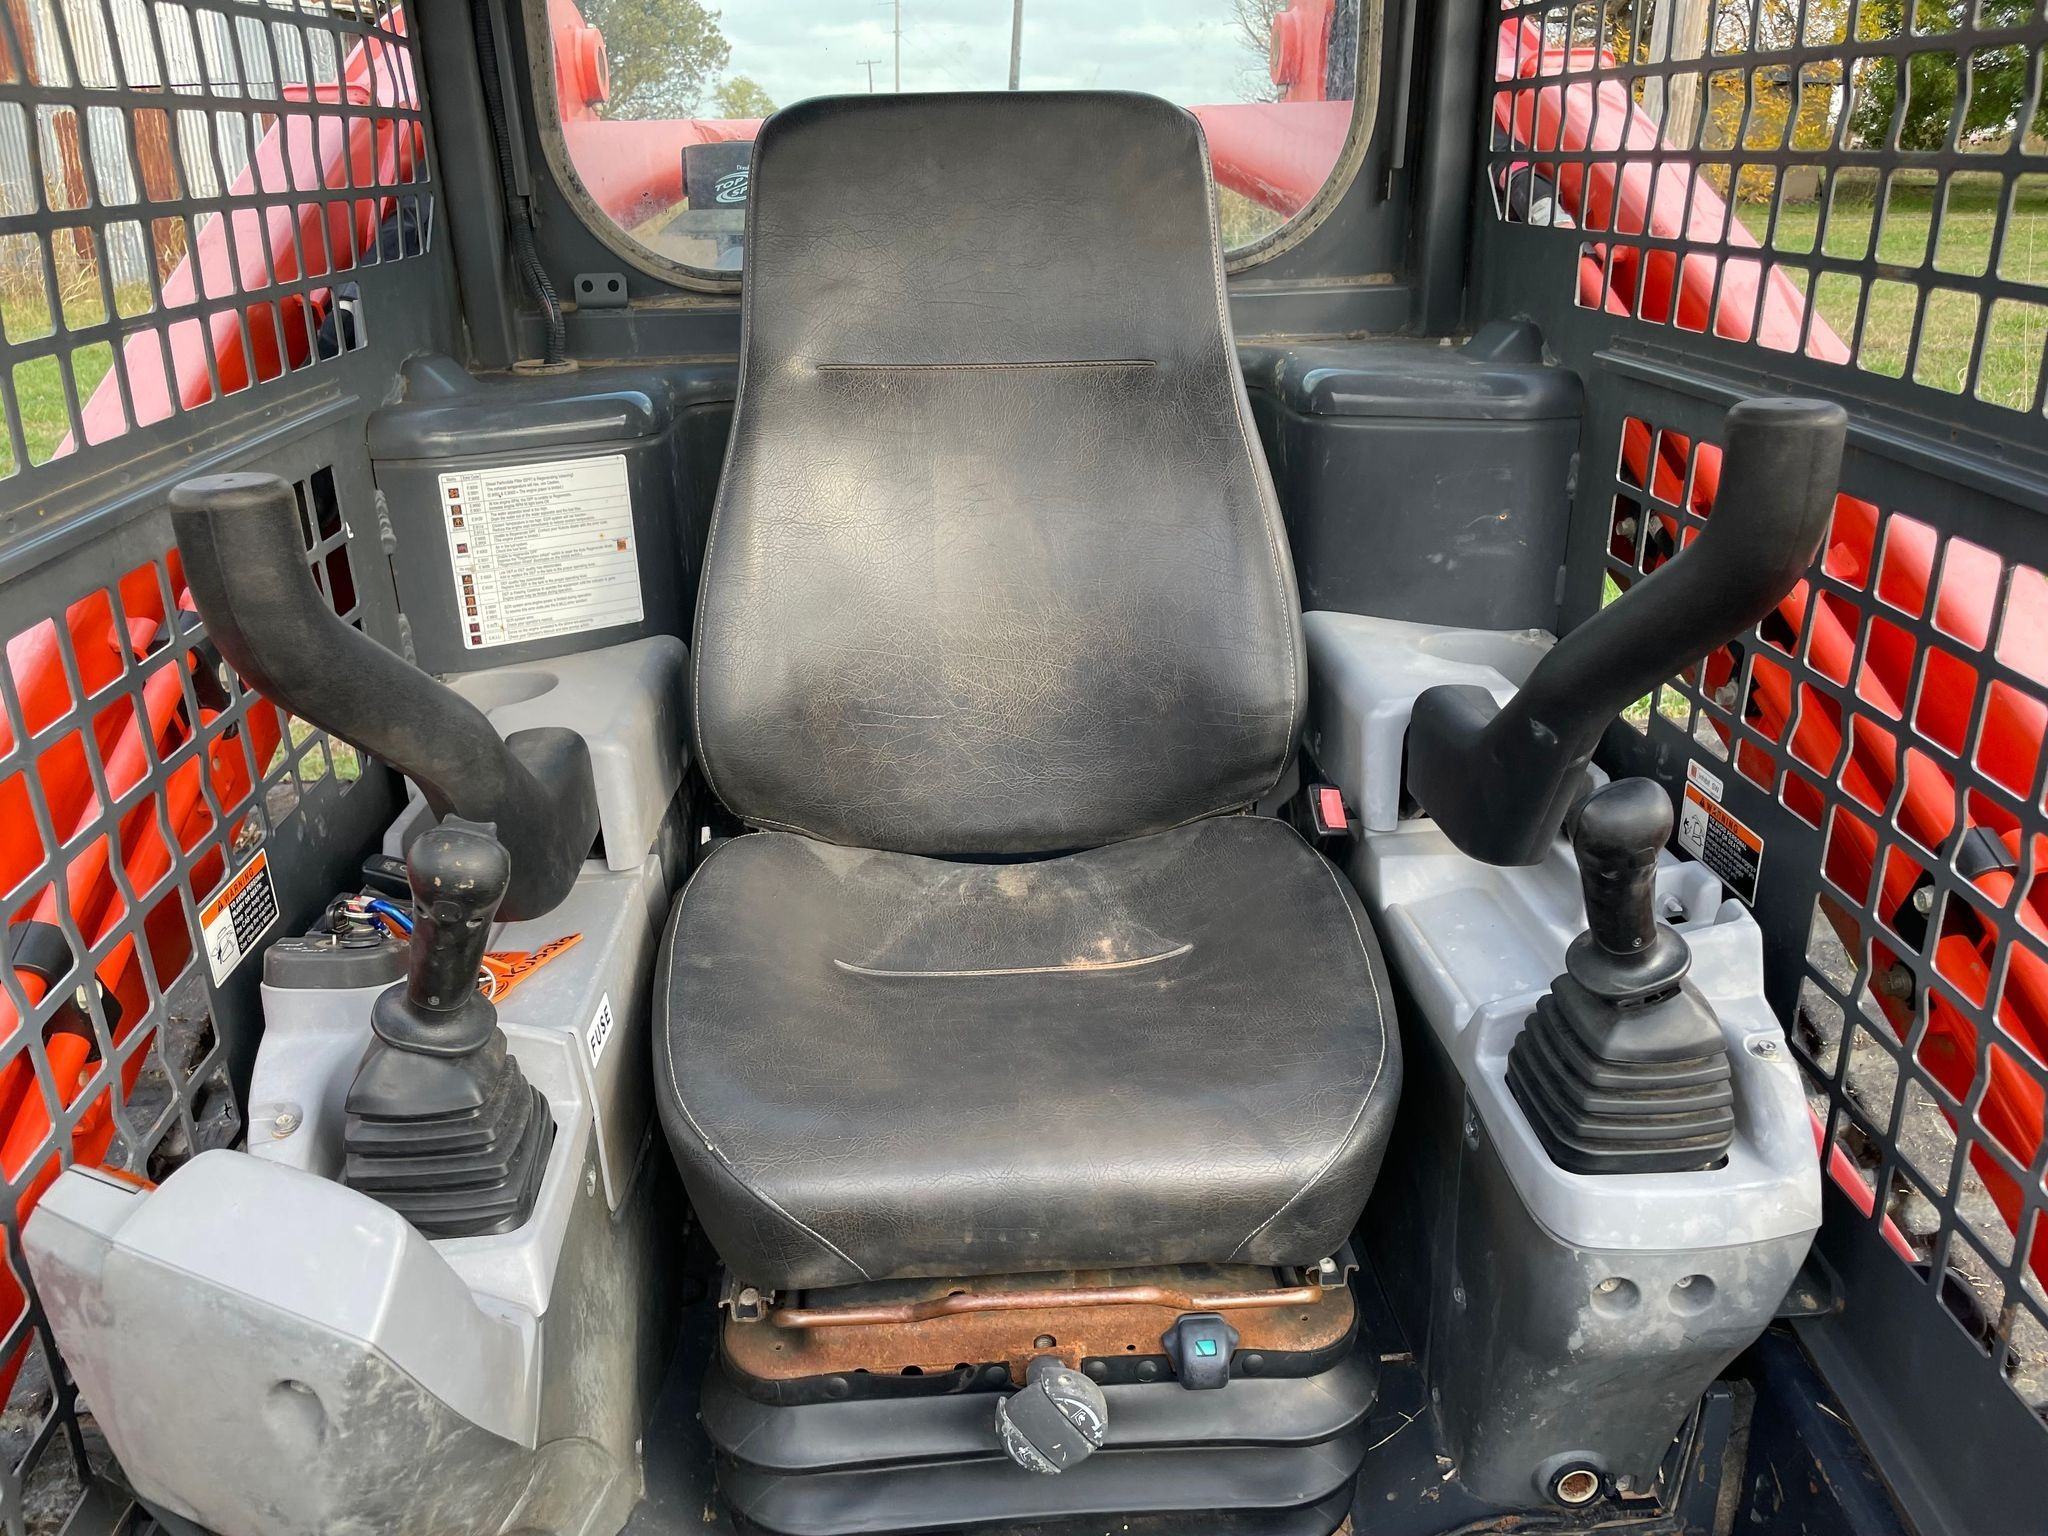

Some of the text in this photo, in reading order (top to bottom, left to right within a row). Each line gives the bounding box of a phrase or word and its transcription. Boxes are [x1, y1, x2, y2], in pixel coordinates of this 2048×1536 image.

[714, 177, 744, 192] TOP
[1707, 803, 1737, 833] WARNING
[225, 868, 253, 903] WARNING
[236, 890, 246, 903] AVOID
[247, 872, 263, 891] PERSONAL
[232, 901, 244, 917] INJURY
[245, 895, 250, 903] OR
[501, 932, 582, 978] Kubota
[590, 1004, 611, 1058] FUSE
